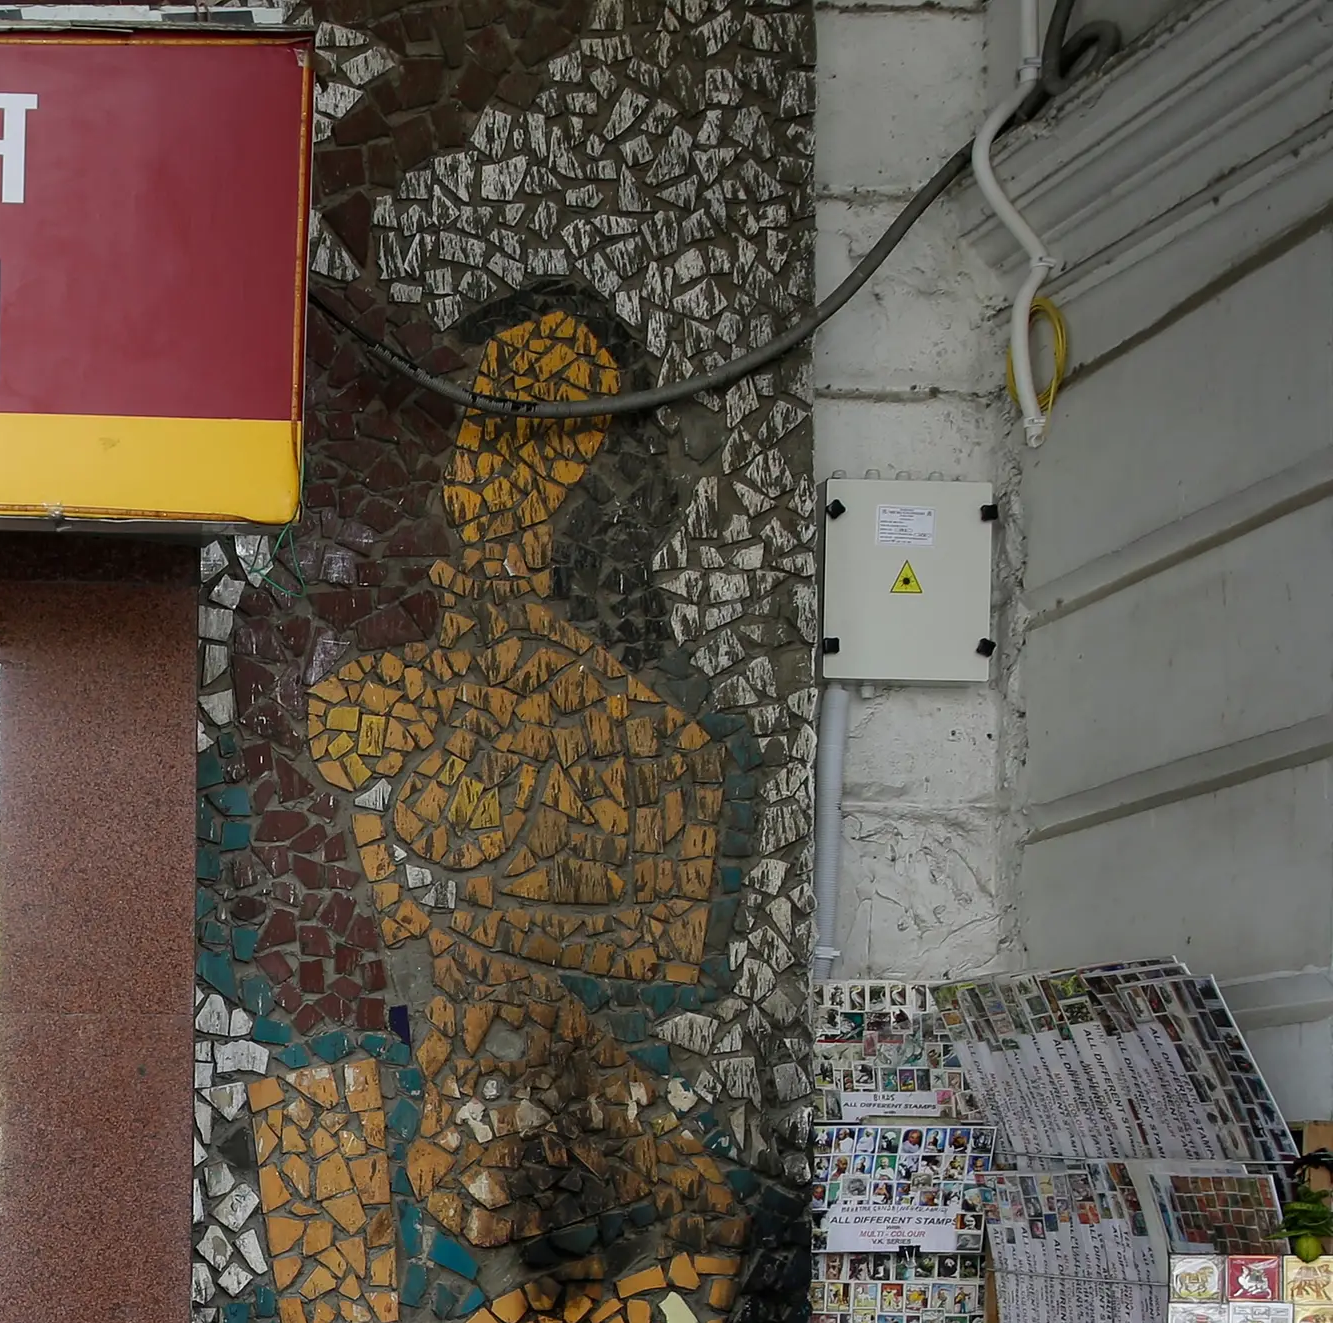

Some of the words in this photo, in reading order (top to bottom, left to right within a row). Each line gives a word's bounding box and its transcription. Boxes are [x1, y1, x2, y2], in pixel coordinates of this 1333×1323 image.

[1081, 1027, 1097, 1050] ALL
[1092, 1050, 1126, 1115] DIFFERENT
[830, 1216, 850, 1224] ALL
[853, 1216, 913, 1224] DIFFERENT
[915, 1217, 957, 1226] STAMPS
[890, 1230, 926, 1238] COLOUR
